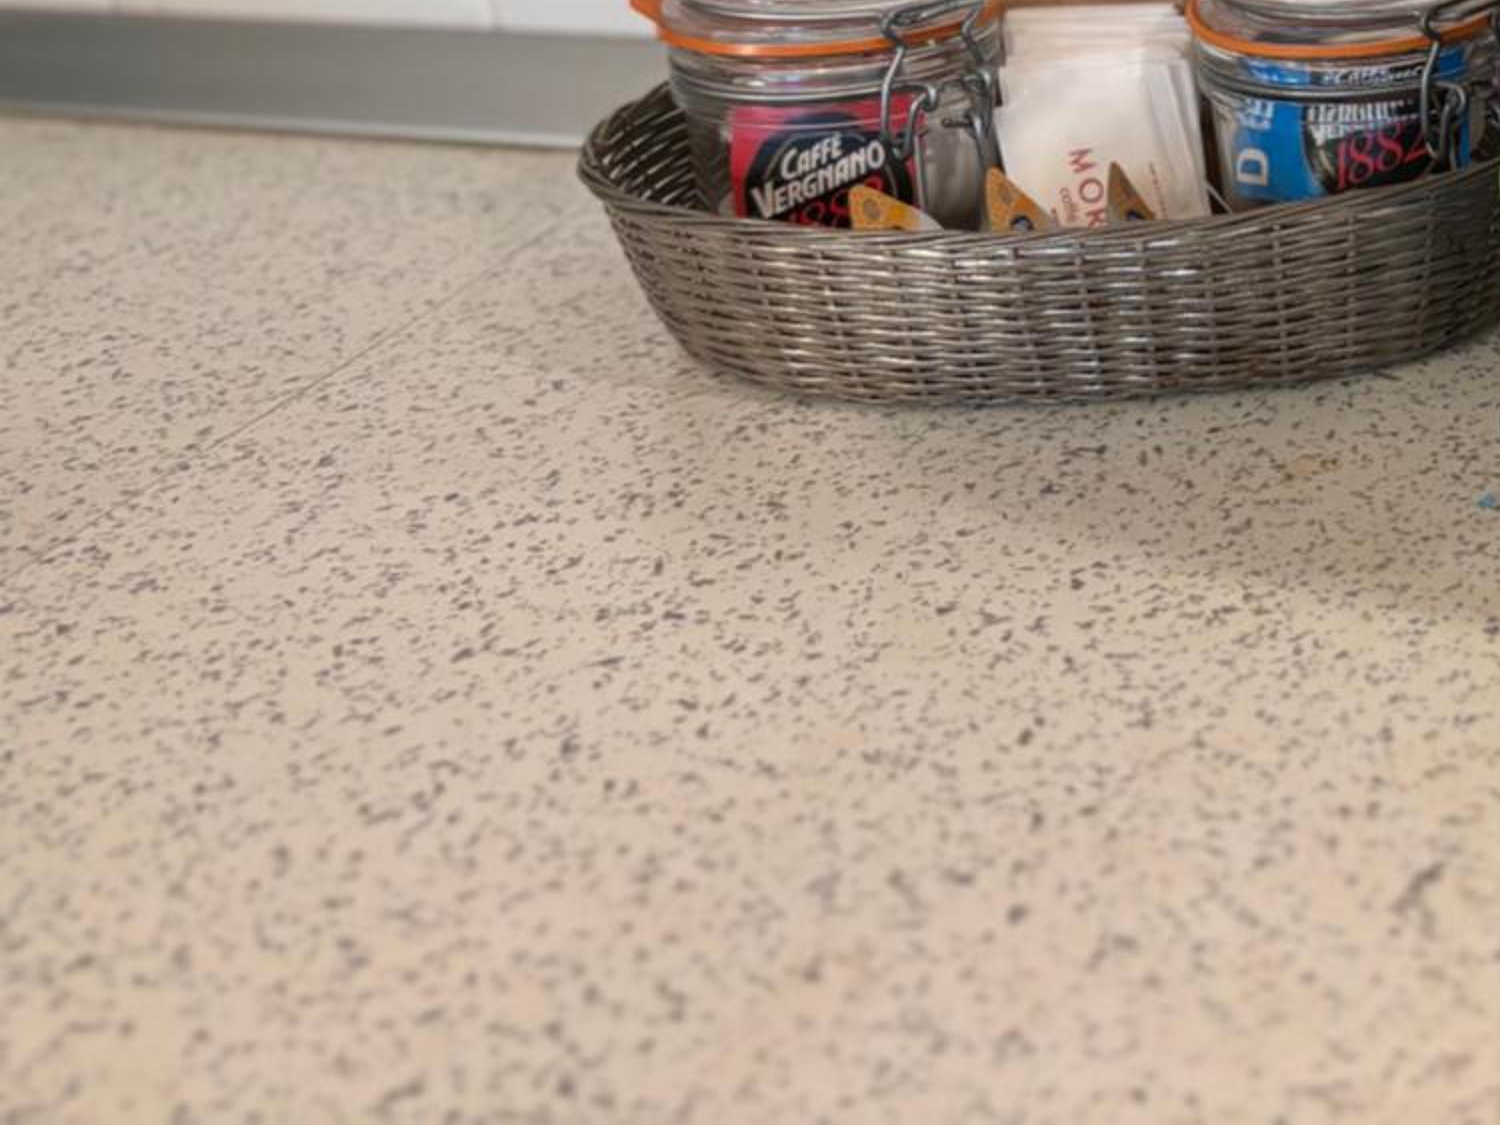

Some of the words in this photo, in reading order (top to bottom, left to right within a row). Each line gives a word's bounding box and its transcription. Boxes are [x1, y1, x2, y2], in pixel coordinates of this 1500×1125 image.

[751, 140, 886, 218] VERGNANO
[1068, 148, 1106, 227] MOK
[1336, 122, 1429, 190] 1882
